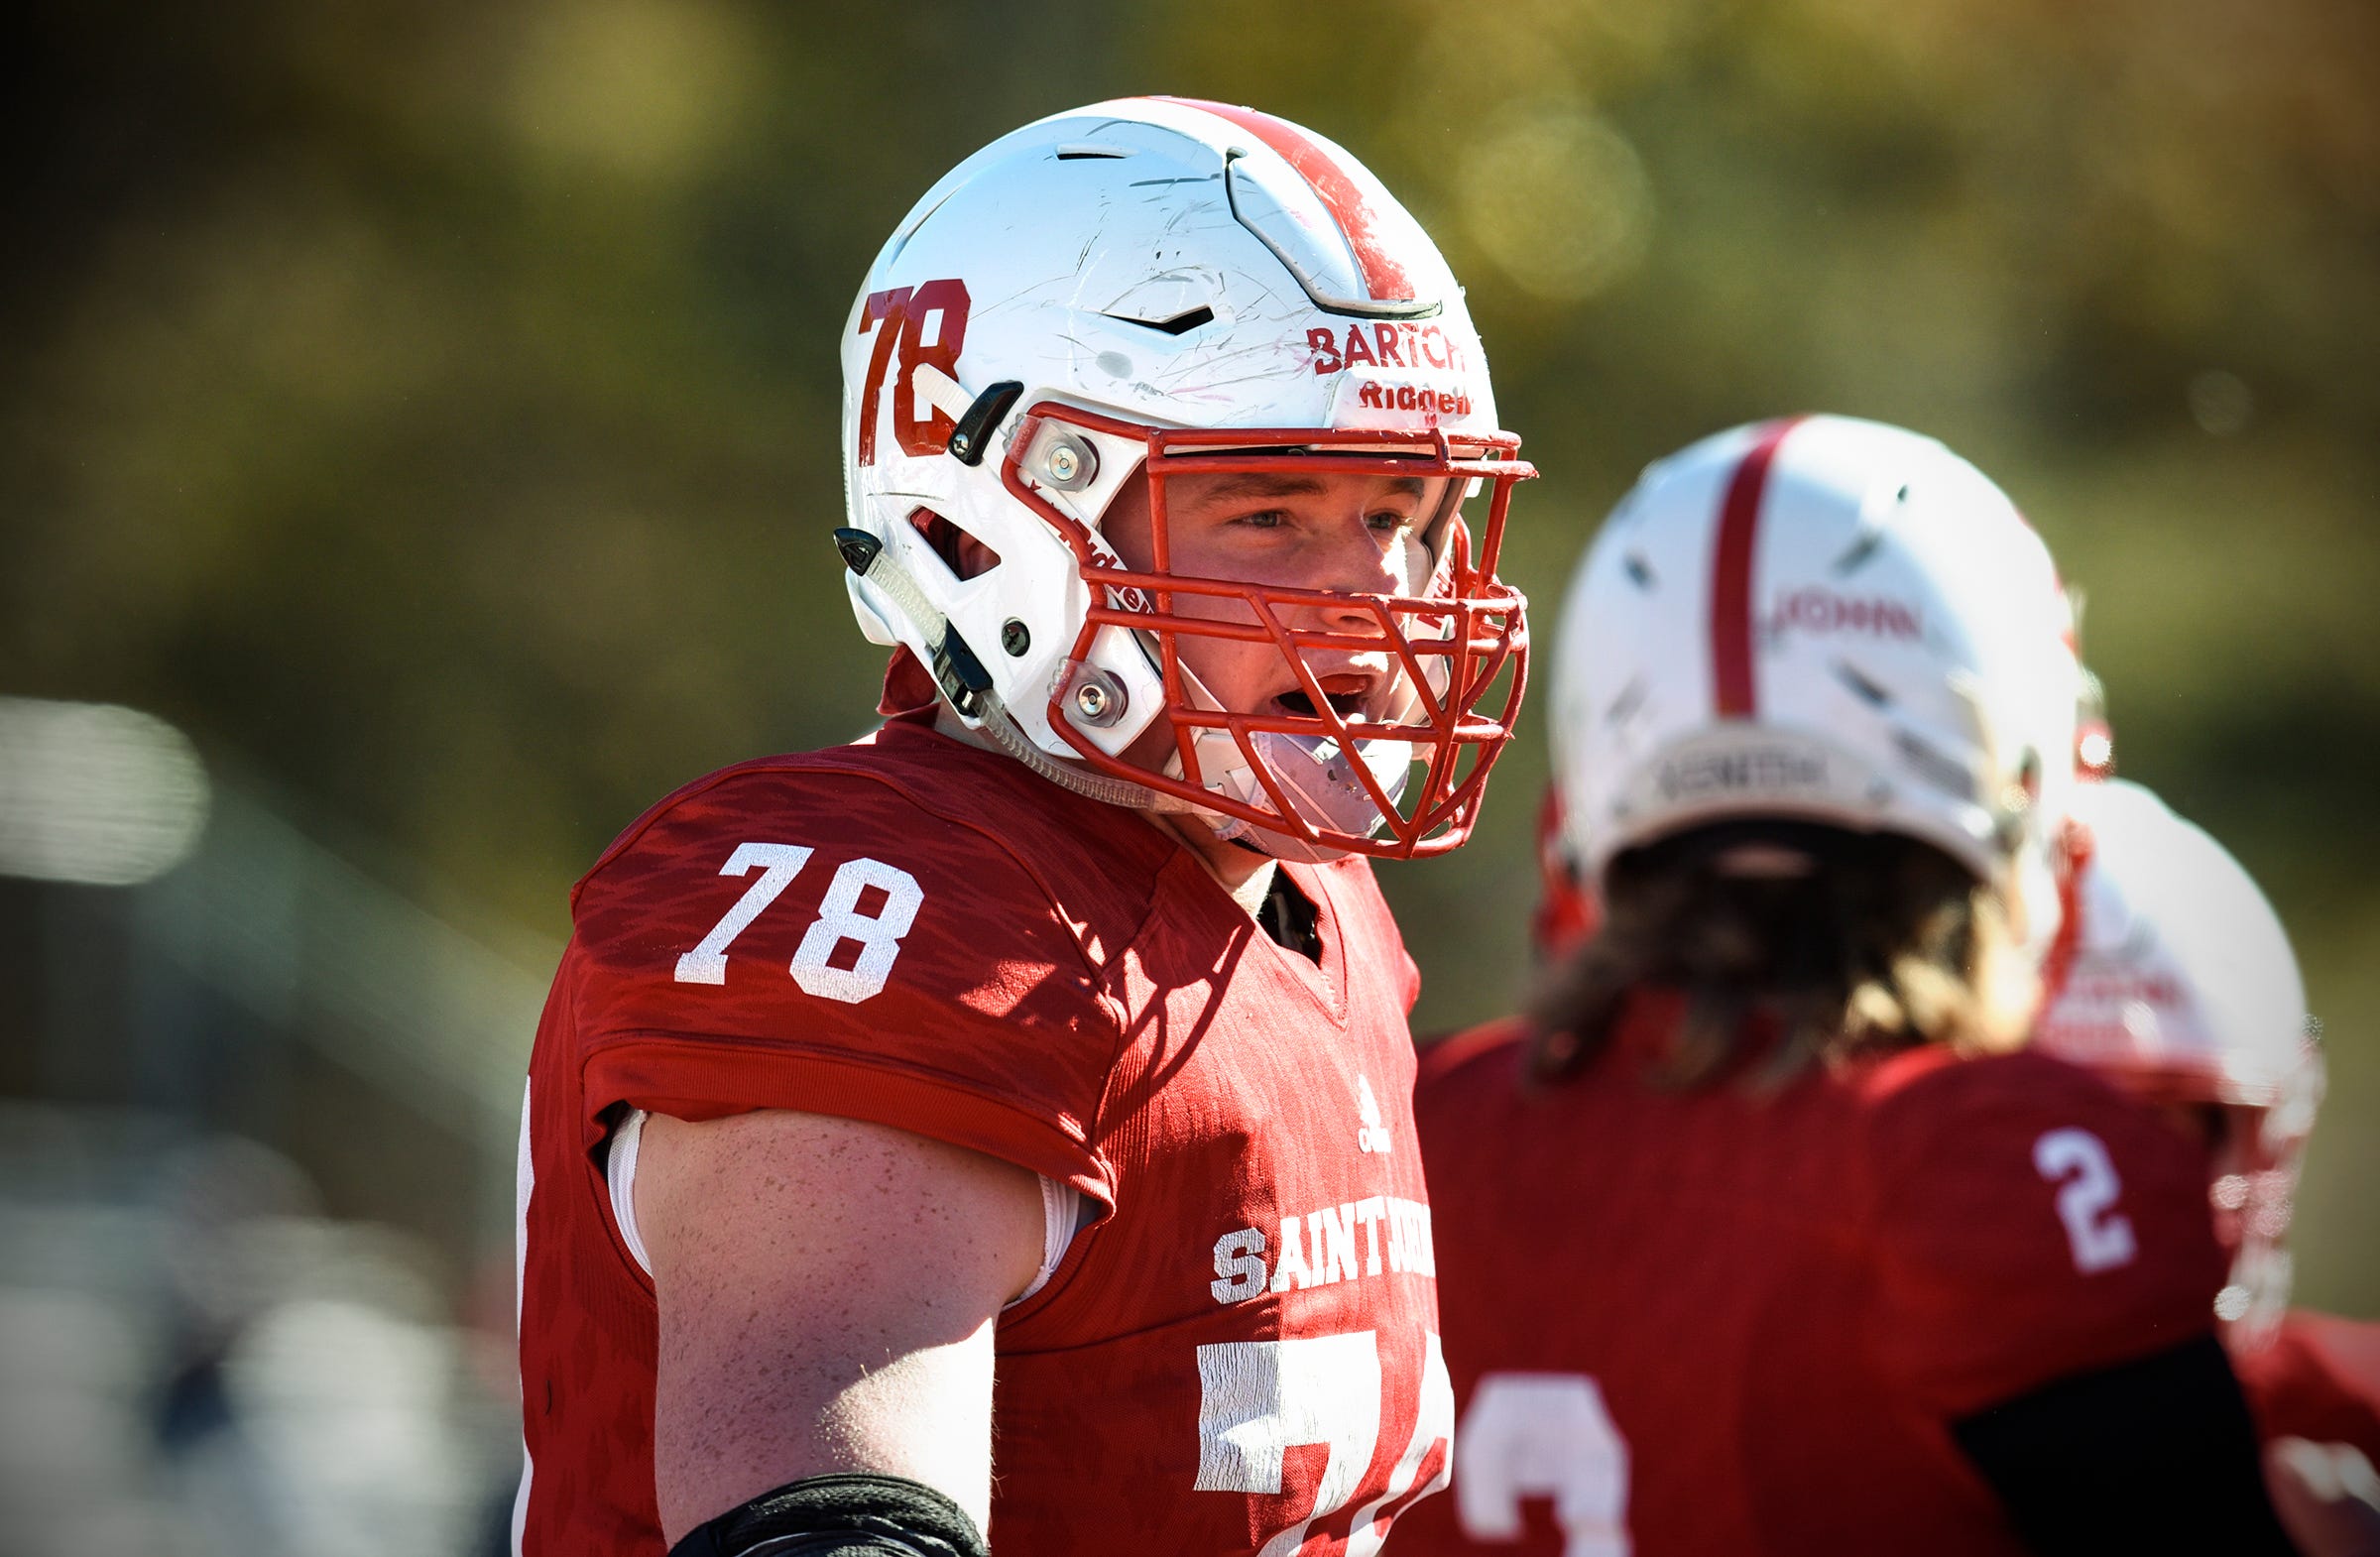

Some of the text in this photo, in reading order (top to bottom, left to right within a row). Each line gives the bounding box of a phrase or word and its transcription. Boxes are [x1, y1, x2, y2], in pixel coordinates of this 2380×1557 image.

[859, 279, 972, 467] 78
[674, 842, 925, 1005] 78
[1211, 1196, 1386, 1304] SAINT
[2033, 1128, 2137, 1273] 2
